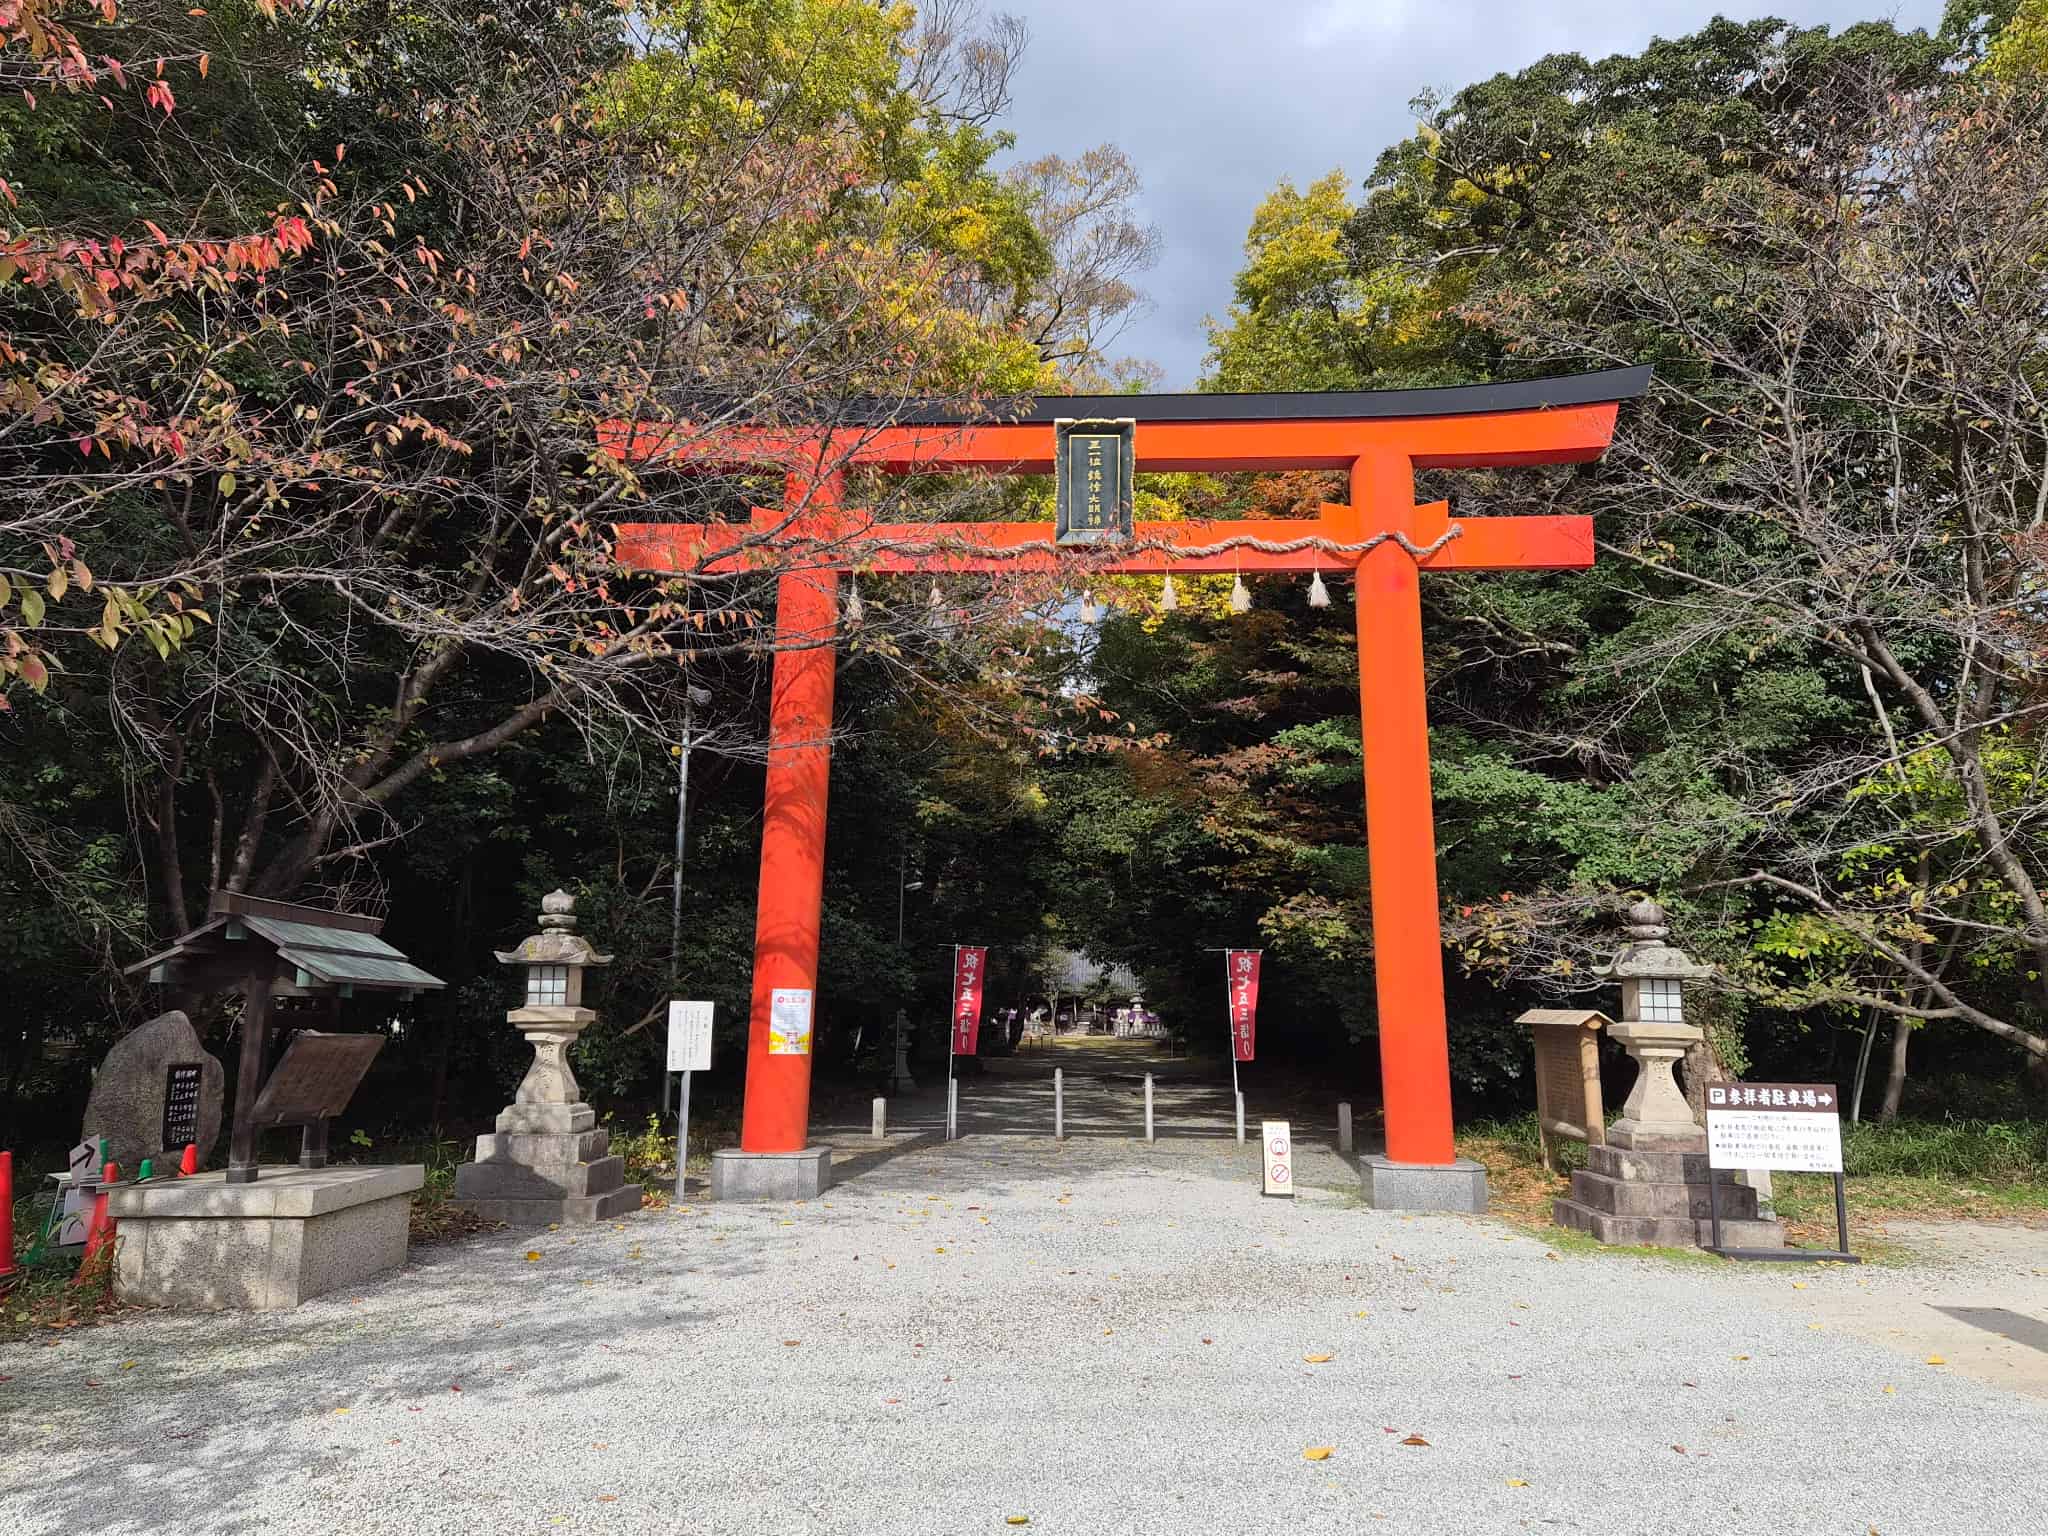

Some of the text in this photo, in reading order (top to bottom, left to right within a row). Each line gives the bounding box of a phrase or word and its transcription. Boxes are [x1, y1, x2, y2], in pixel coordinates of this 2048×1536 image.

[1711, 1087, 1817, 1108] P 参拝者駐車場
